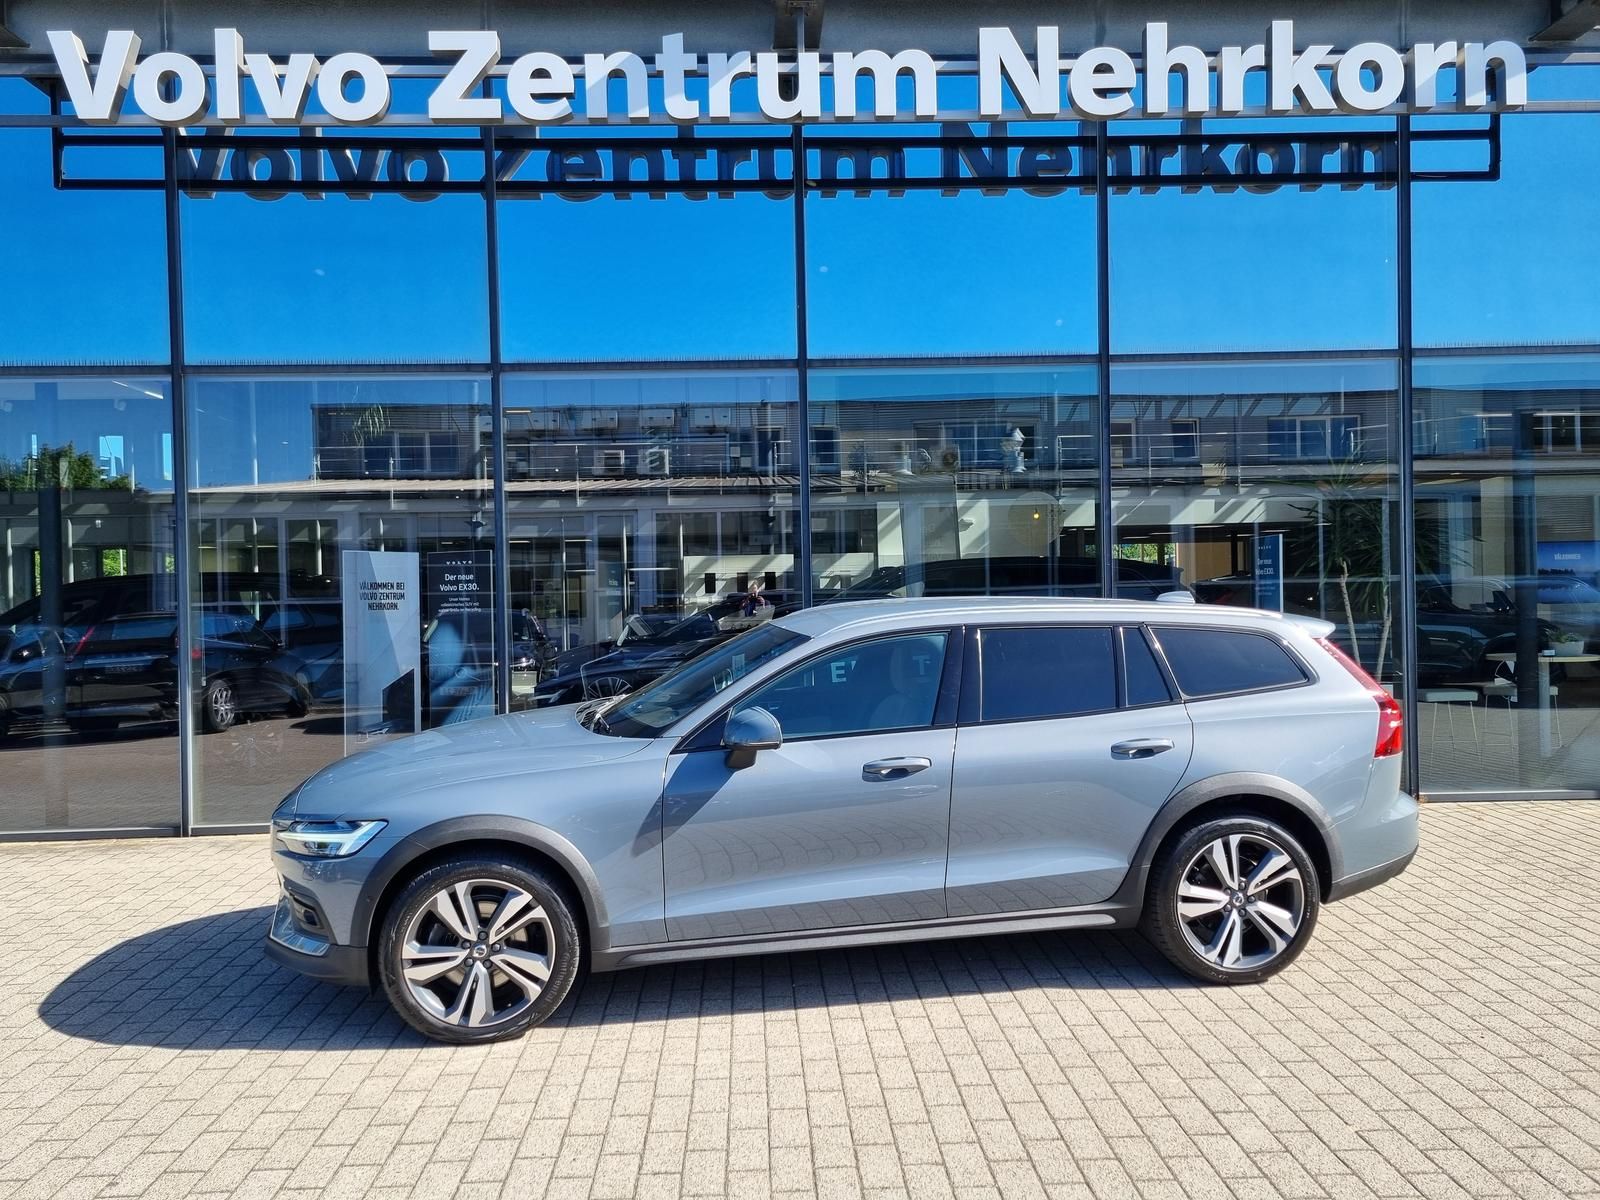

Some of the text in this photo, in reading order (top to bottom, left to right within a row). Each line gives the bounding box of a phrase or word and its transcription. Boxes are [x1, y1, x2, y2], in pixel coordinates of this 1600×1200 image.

[46, 19, 1528, 125] Volvo Zentrum Nehrkorn
[444, 573, 457, 581] Der
[396, 582, 405, 590] BEI
[458, 583, 480, 591] EX30.
[360, 592, 405, 600] VOLVO ZENTRUM
[367, 602, 399, 610] NEHRKORN.
